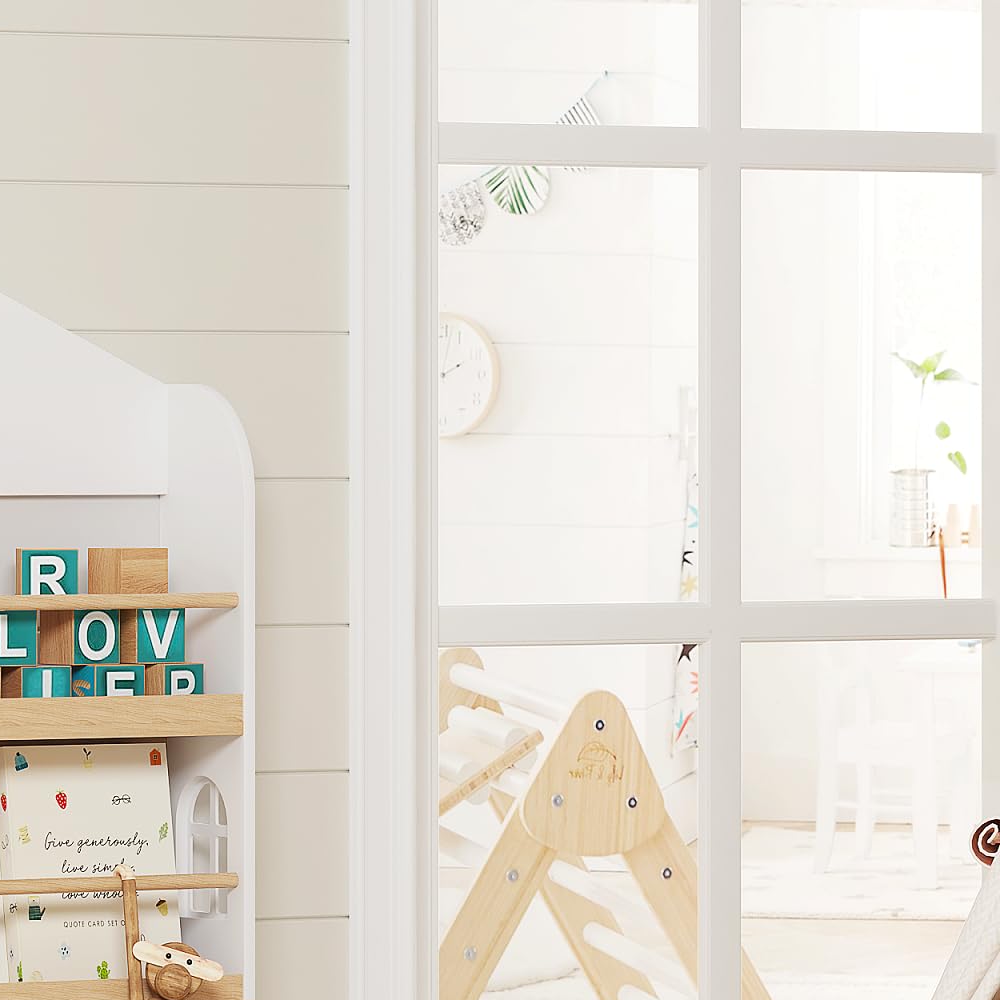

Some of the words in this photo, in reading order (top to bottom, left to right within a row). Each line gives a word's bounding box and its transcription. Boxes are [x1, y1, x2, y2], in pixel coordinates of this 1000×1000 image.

[29, 555, 67, 595] R
[78, 611, 116, 661] O
[142, 610, 180, 659] V
[44, 831, 74, 850] Give
[61, 860, 89, 874] live
[63, 920, 85, 928] QUOTE
